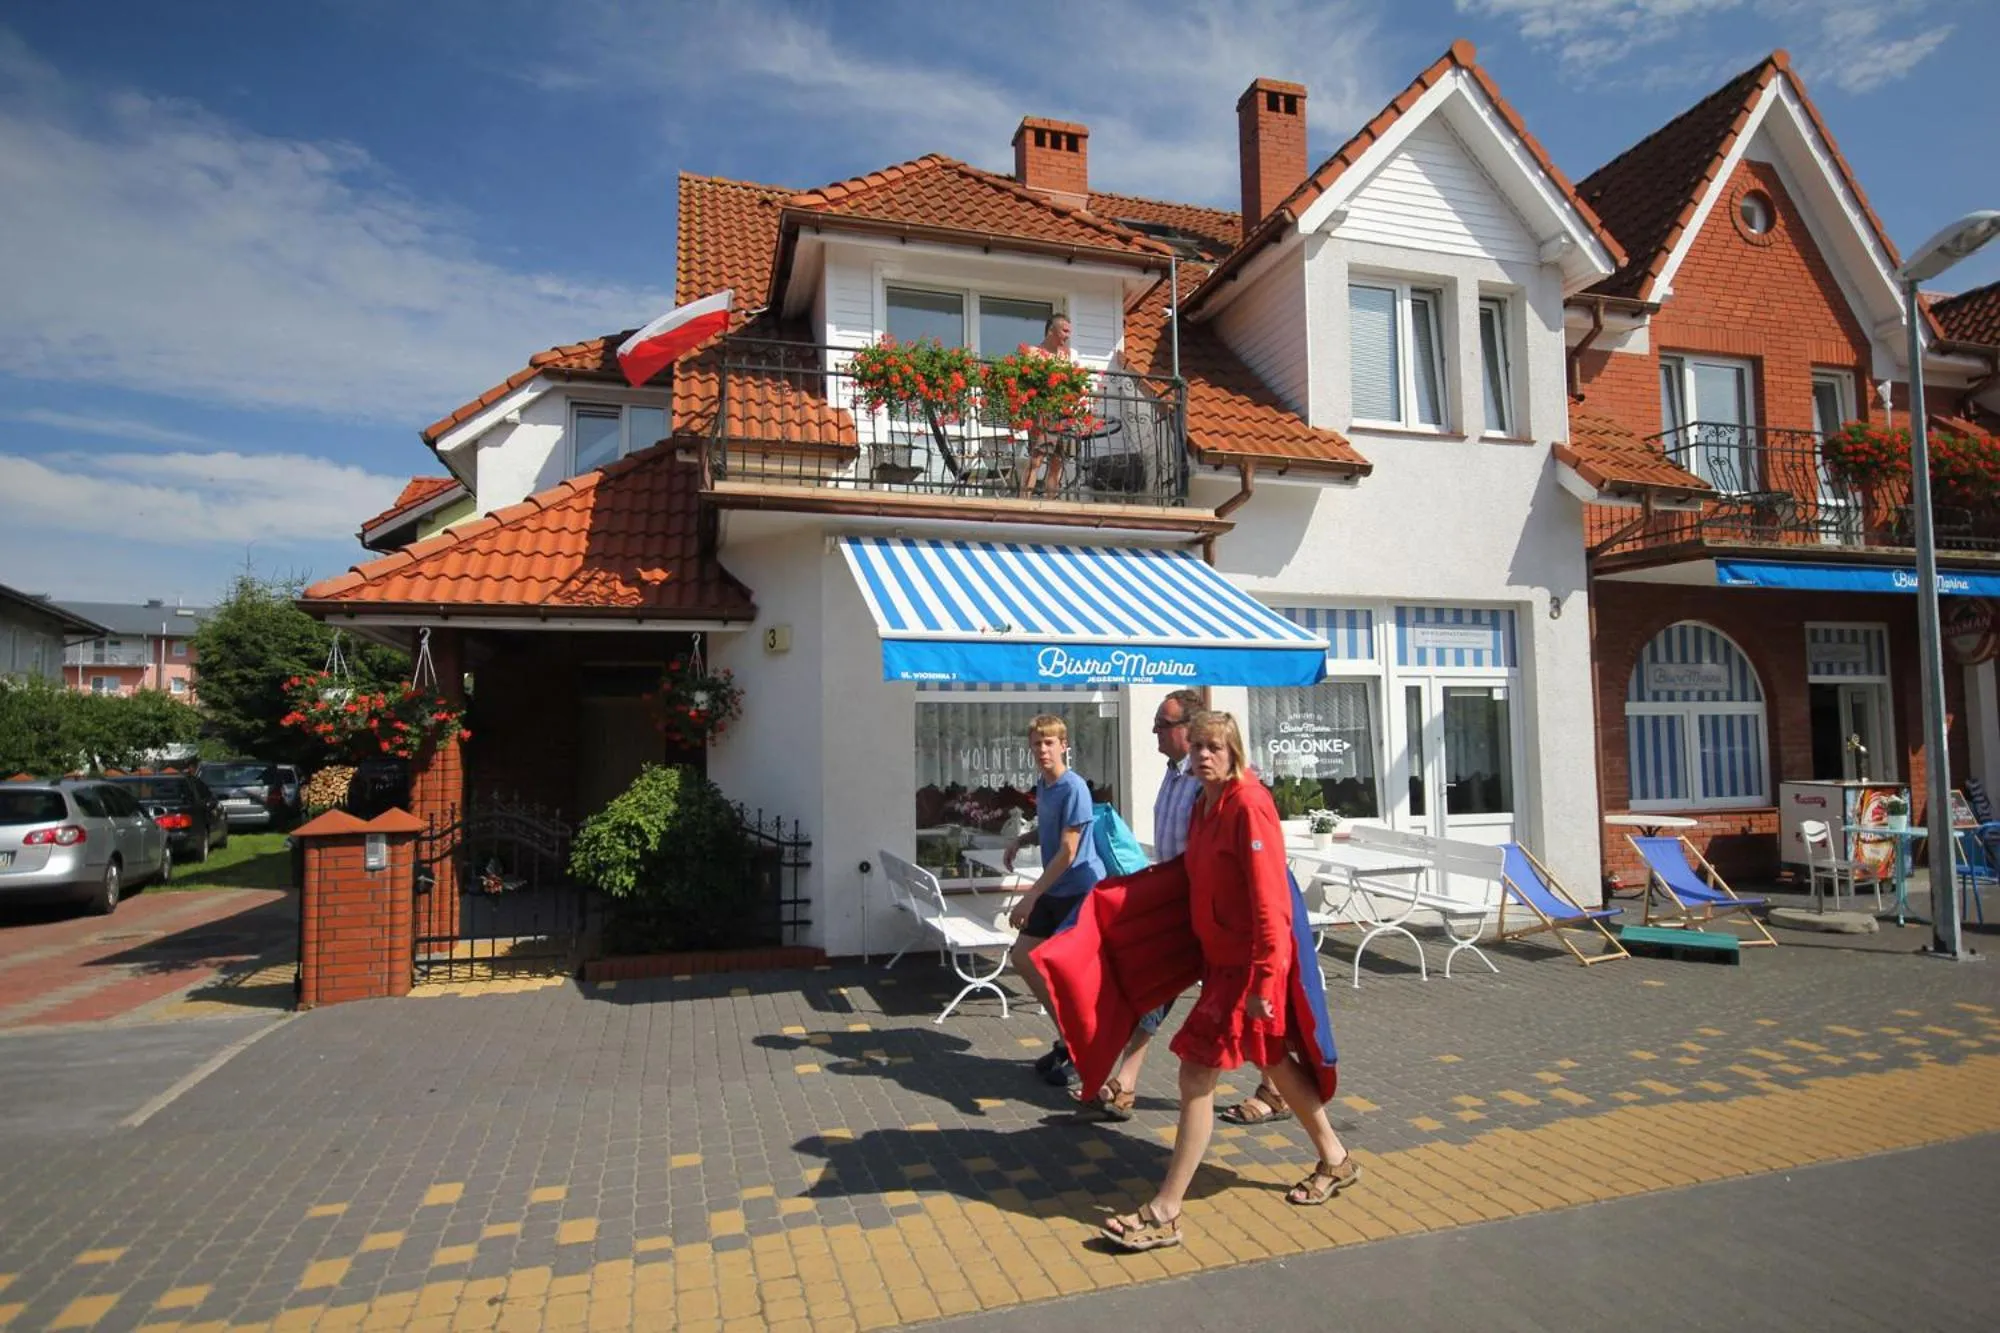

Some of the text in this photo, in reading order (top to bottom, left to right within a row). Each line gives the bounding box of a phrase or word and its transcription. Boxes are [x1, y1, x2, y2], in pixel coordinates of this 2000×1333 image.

[1893, 569, 1919, 588] Bist
[768, 628, 777, 649] 3
[1038, 647, 1198, 678] Bistro Marina
[960, 746, 1073, 770] WOLNE POE
[981, 773, 1005, 788] 602
